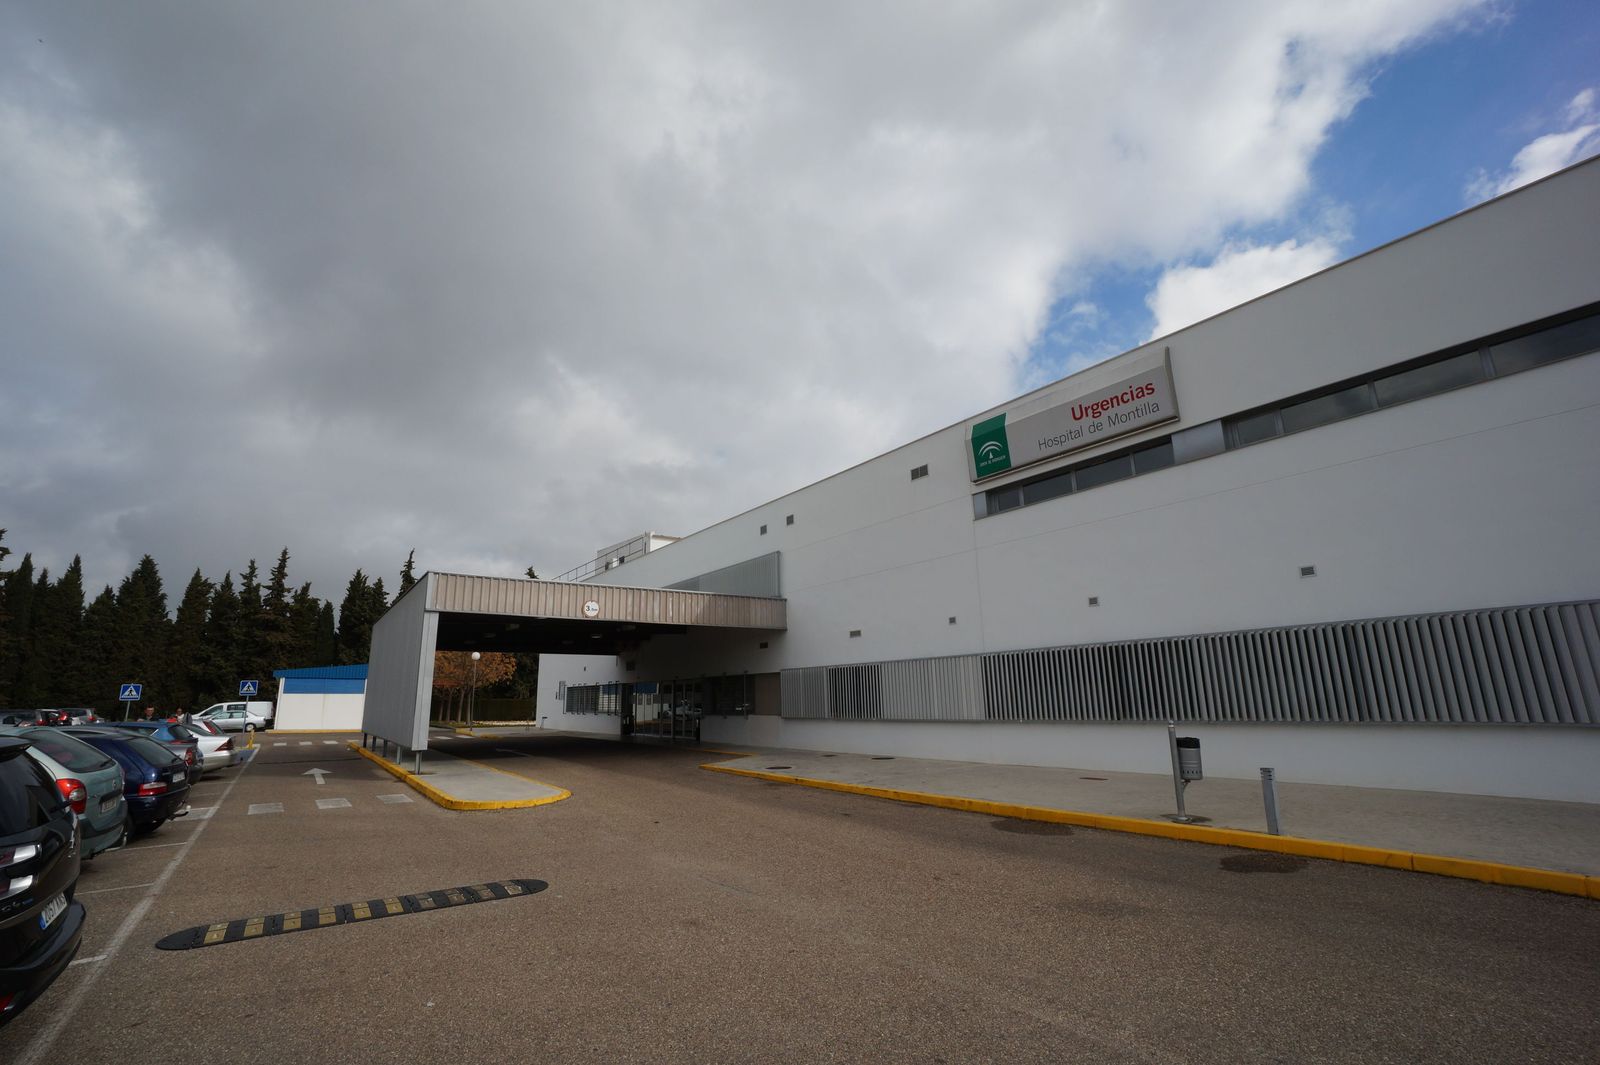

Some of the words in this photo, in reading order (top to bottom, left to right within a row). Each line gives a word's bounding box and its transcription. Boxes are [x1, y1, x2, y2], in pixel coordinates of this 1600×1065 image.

[1071, 383, 1155, 421] Urgencias
[1038, 426, 1084, 450] Hospital
[1088, 421, 1103, 434] de
[1108, 401, 1160, 428] Montilla
